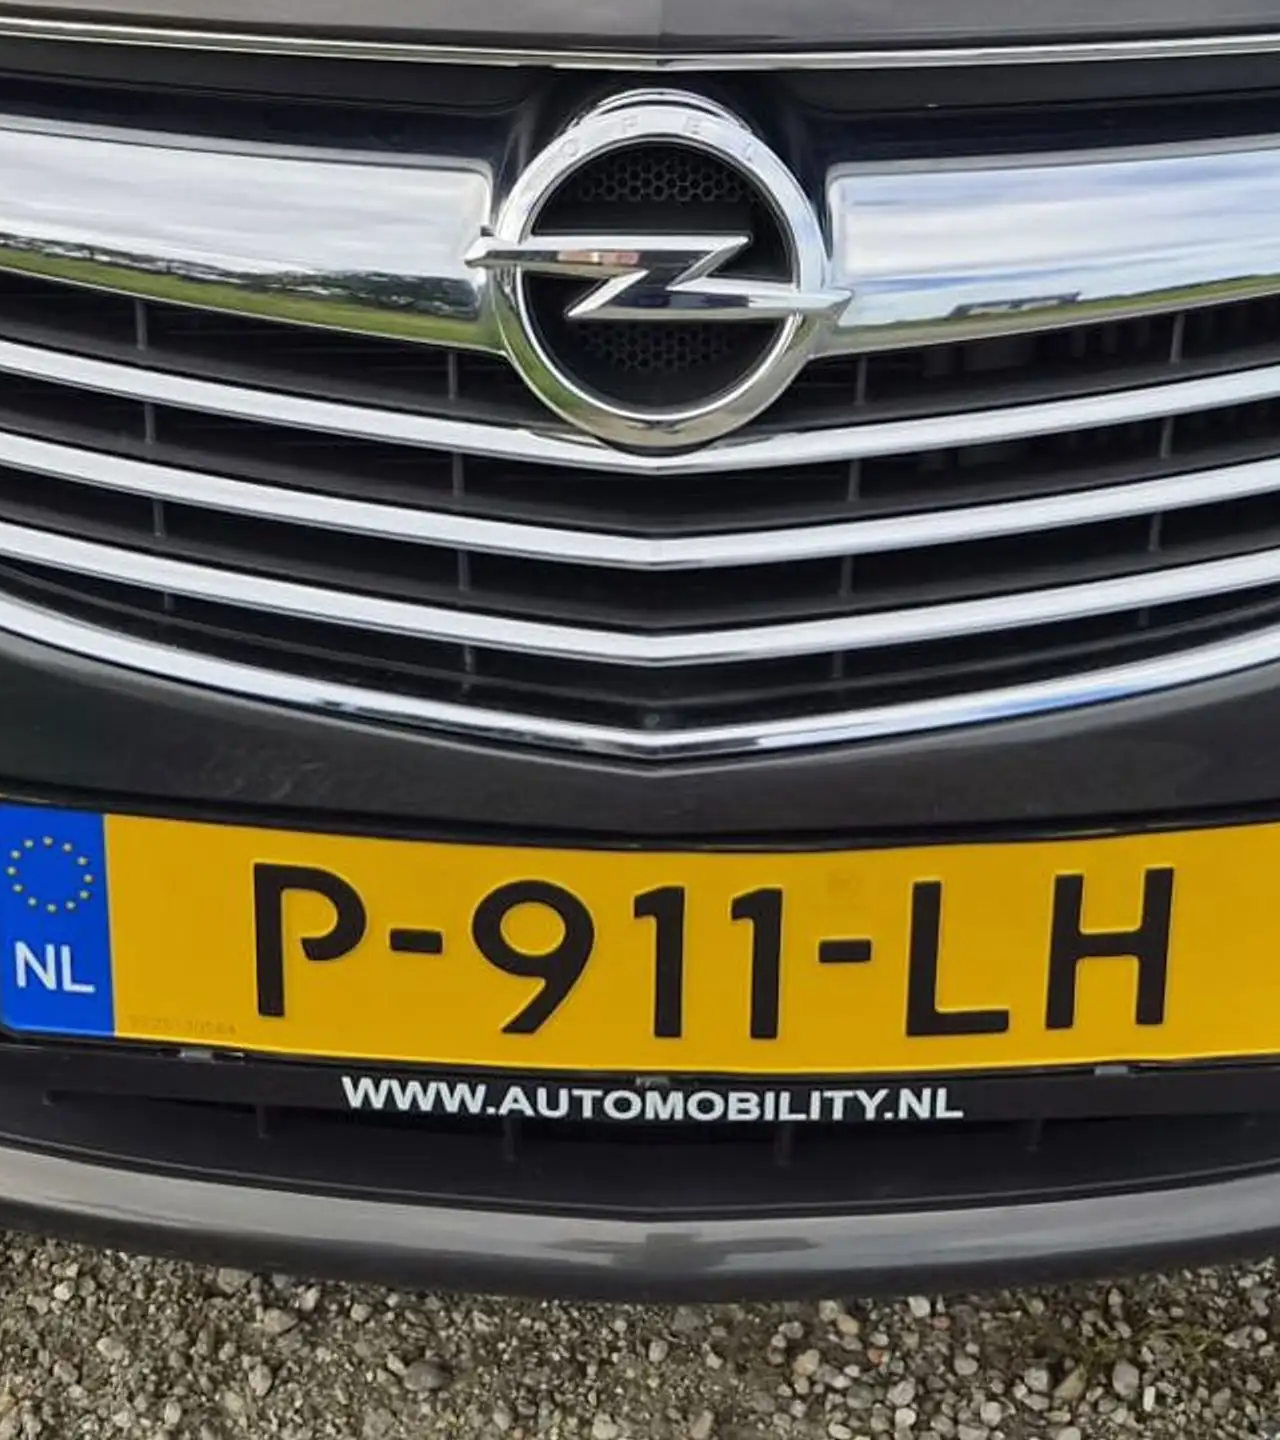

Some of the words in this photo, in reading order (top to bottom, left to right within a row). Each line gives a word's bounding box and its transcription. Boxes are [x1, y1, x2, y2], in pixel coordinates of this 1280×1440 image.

[15, 941, 95, 993] NL
[253, 864, 1174, 1040] P-911-LH
[342, 1075, 964, 1121] WWW.AUTOMOBILITY.NL
